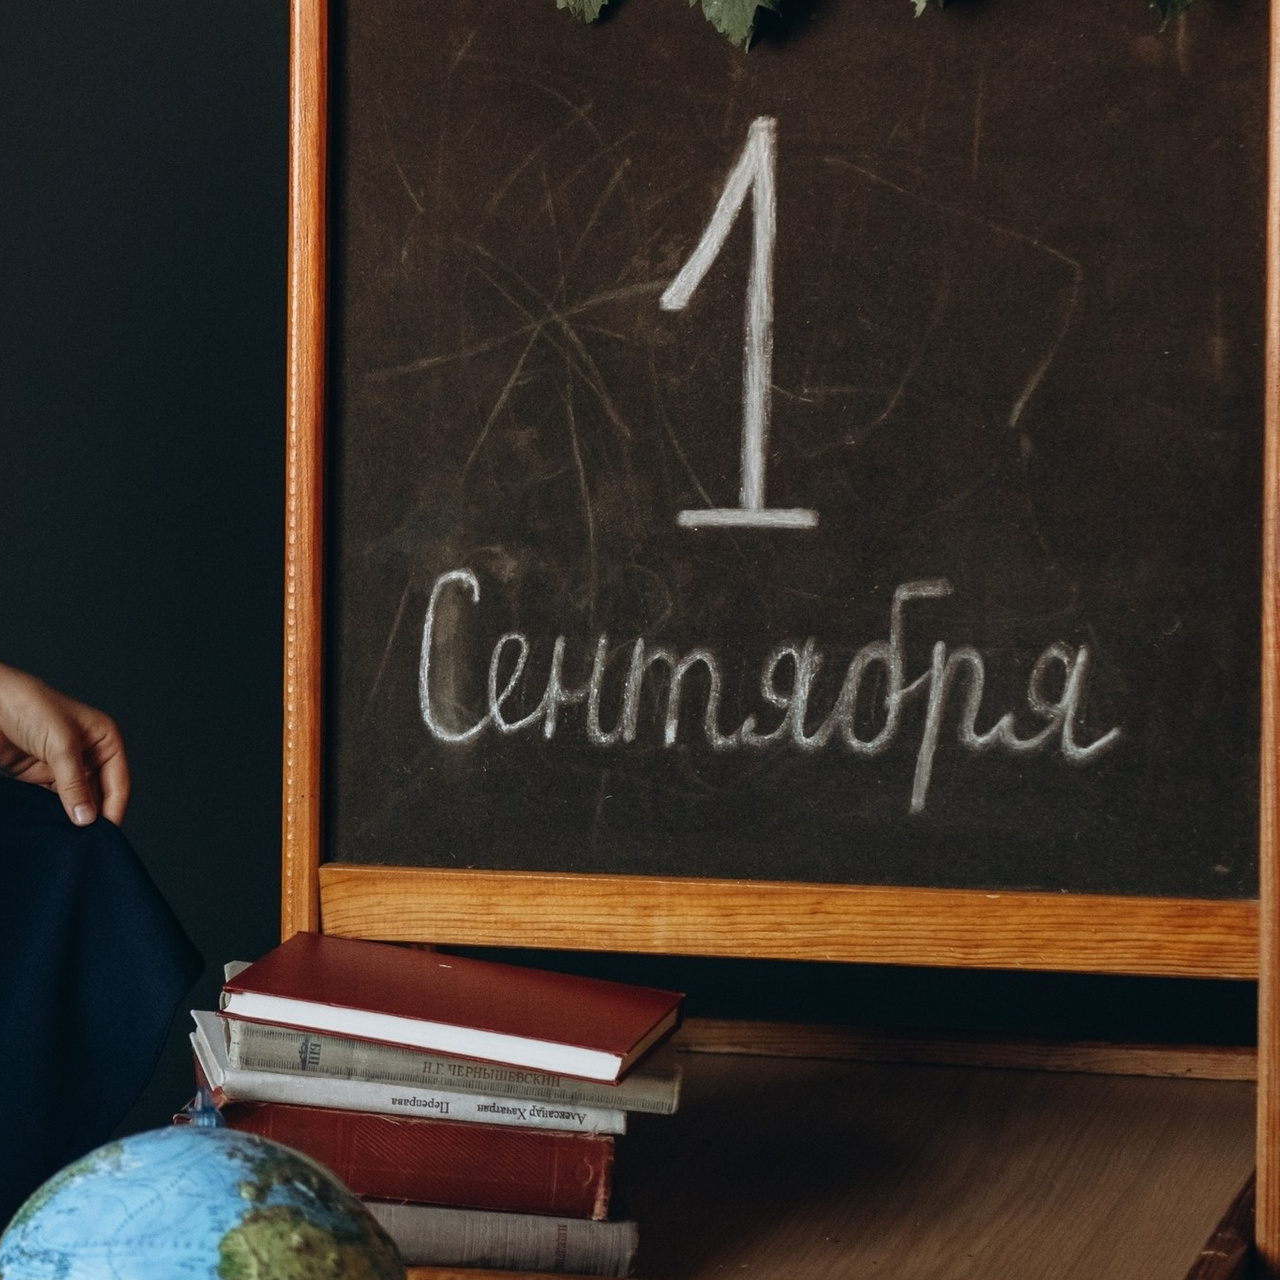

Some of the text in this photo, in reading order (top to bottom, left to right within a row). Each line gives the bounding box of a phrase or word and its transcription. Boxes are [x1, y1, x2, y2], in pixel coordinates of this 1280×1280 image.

[658, 115, 819, 529] 1
[418, 569, 1122, 814] Сентября
[391, 1096, 587, 1125] Александр Хачатрян Переправа
